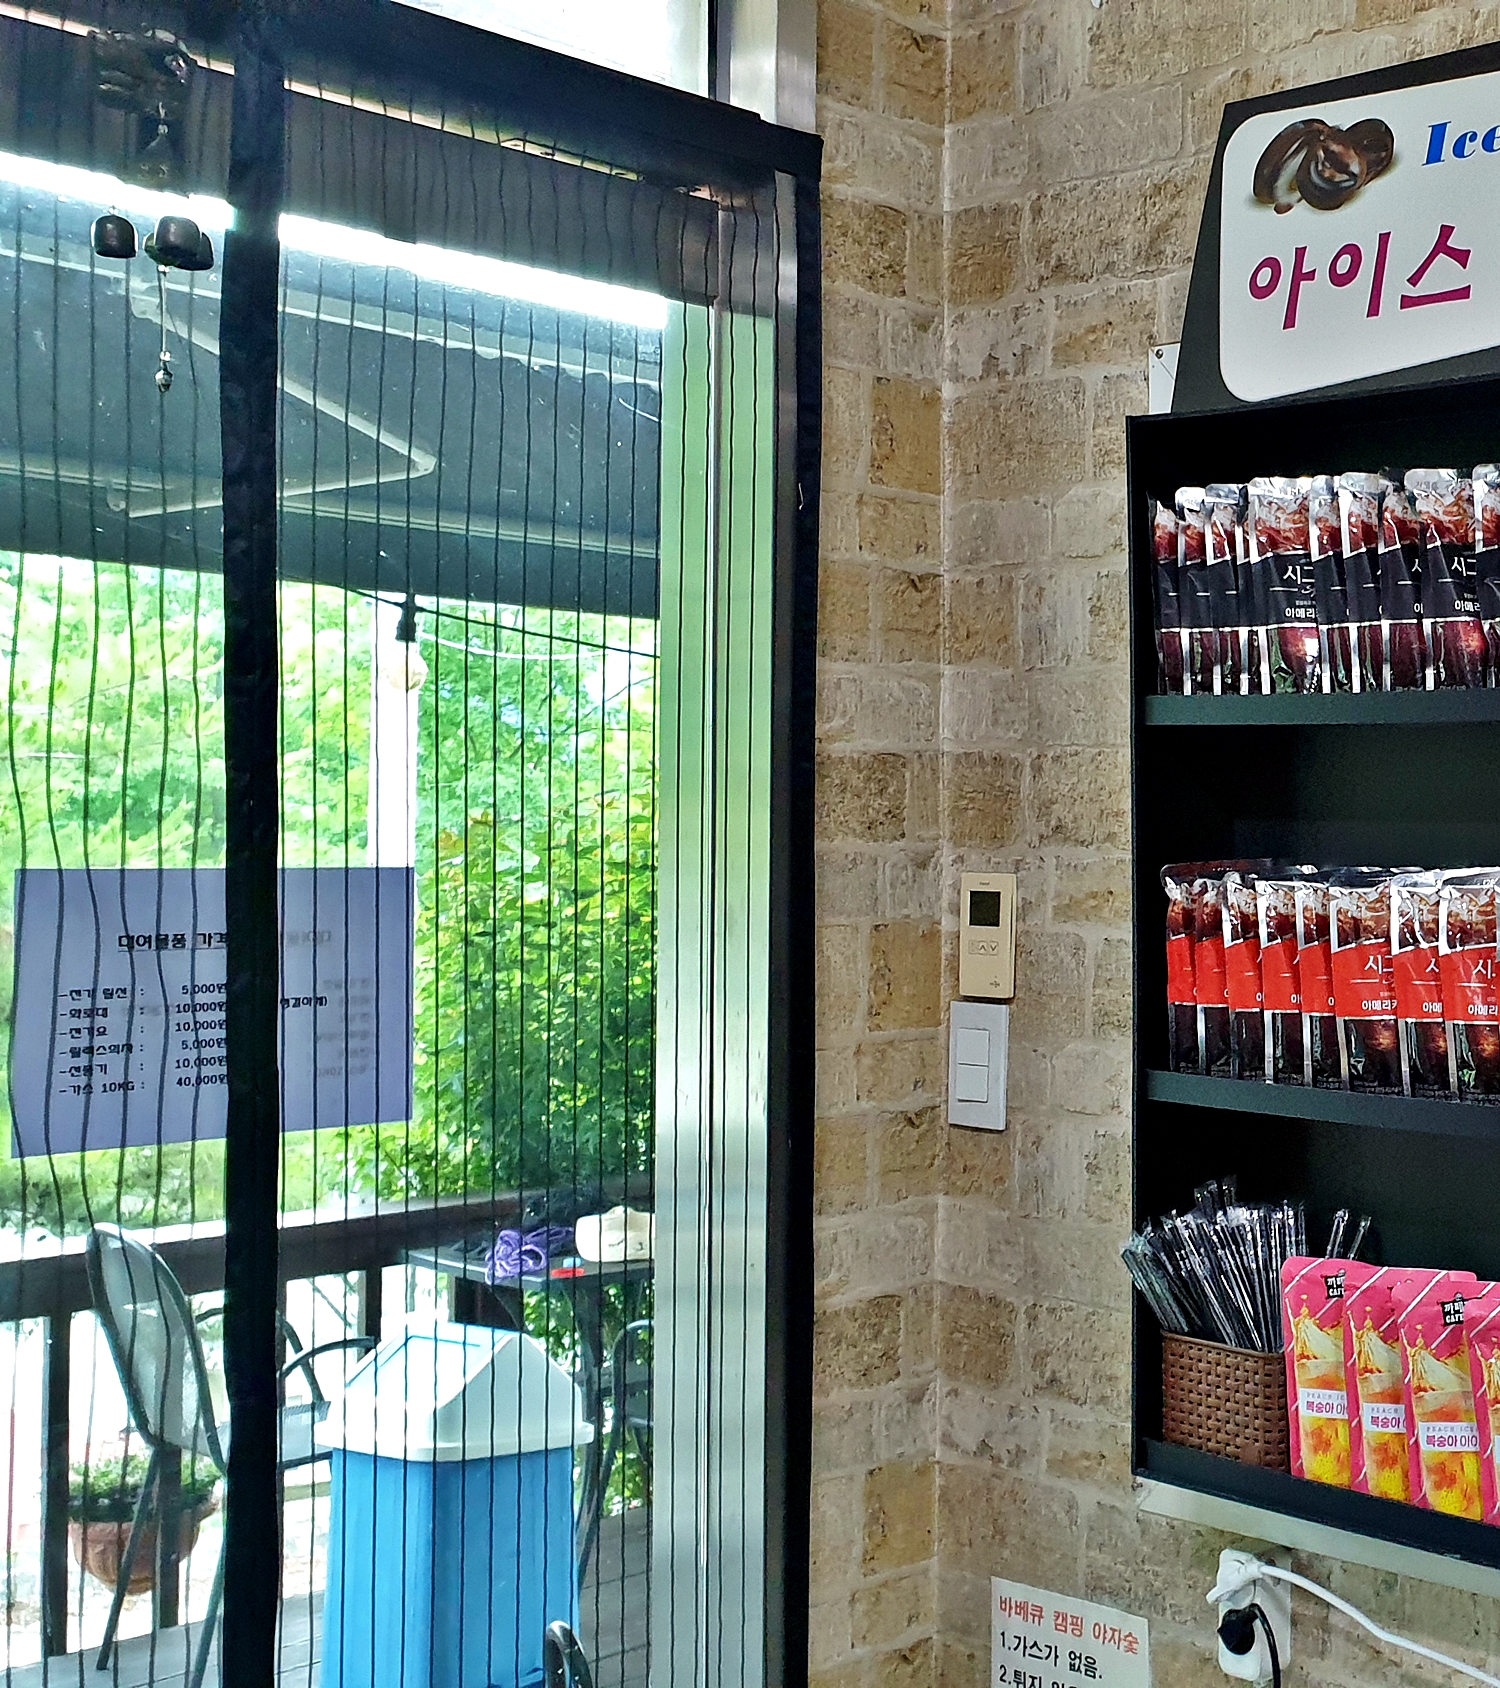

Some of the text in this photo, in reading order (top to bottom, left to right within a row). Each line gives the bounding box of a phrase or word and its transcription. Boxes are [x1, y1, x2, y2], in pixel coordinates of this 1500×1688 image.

[1248, 223, 1472, 331] 아이스
[1285, 607, 1315, 619] 아메리
[1468, 1004, 1498, 1016] 아메리
[1306, 1401, 1334, 1414] 복숭아
[1371, 1416, 1400, 1429] 복숭아
[1426, 1435, 1458, 1447] 복숭아
[1000, 1595, 1139, 1655] 바베큐 캠핑 야자숯
[1000, 1631, 1103, 1680] 1.가스가 없음.
